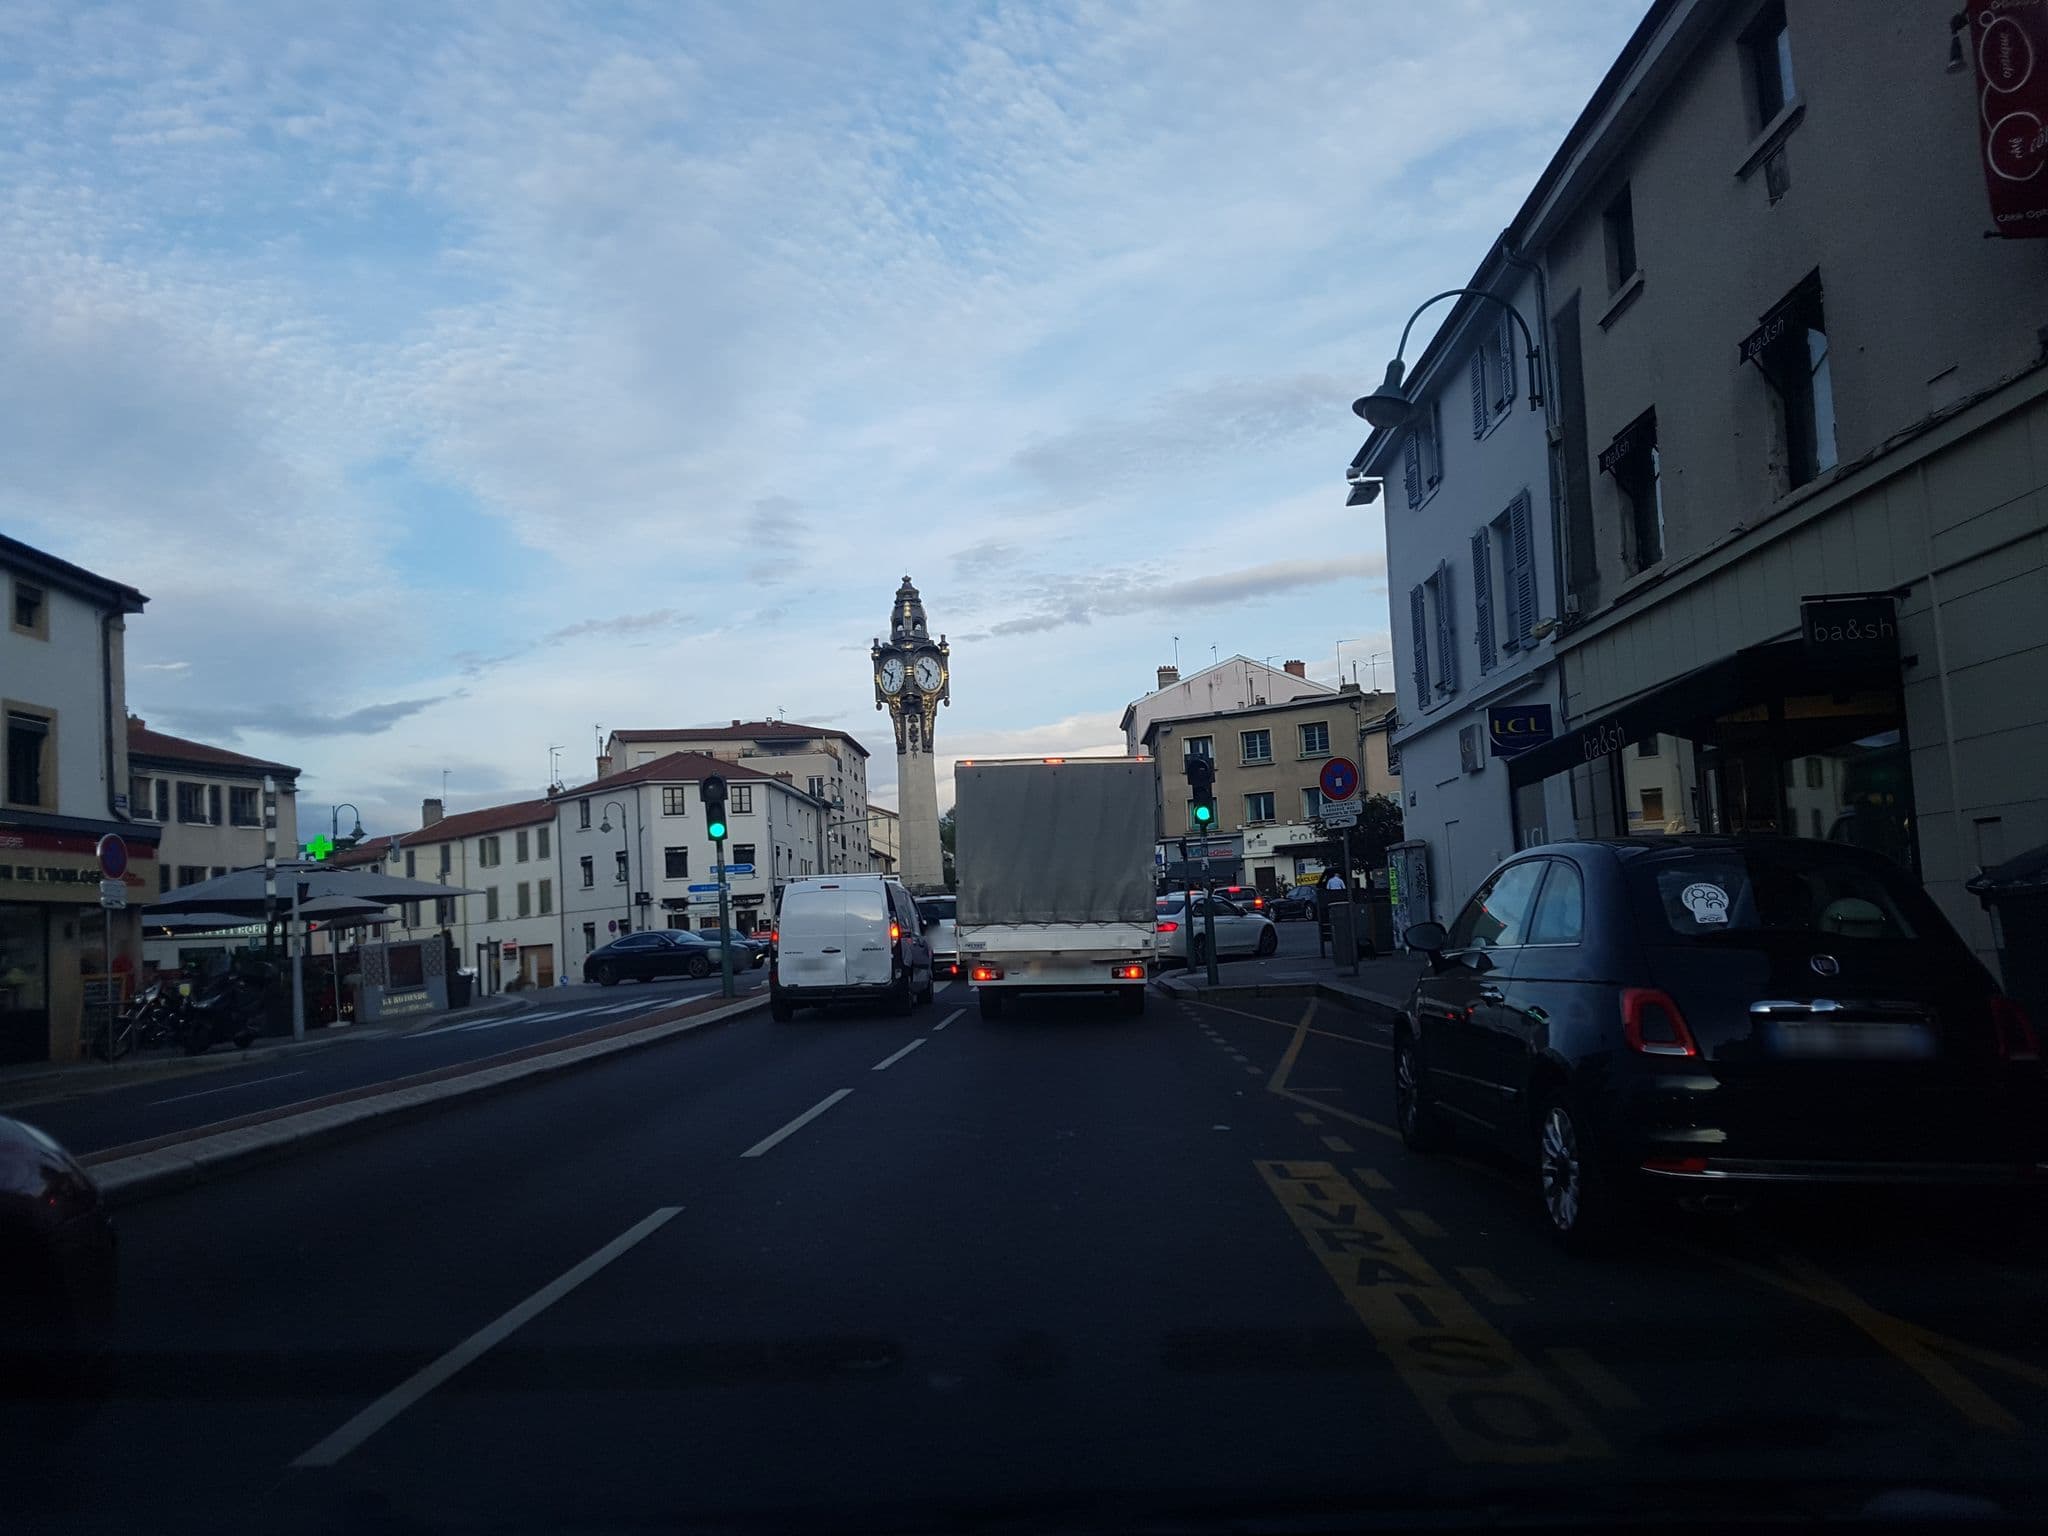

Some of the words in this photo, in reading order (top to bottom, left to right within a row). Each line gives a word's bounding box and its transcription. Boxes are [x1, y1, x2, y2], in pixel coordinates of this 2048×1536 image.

[1814, 617, 1895, 641] ba&sh
[1494, 716, 1545, 734] LCL
[1583, 719, 1626, 761] ba&sh
